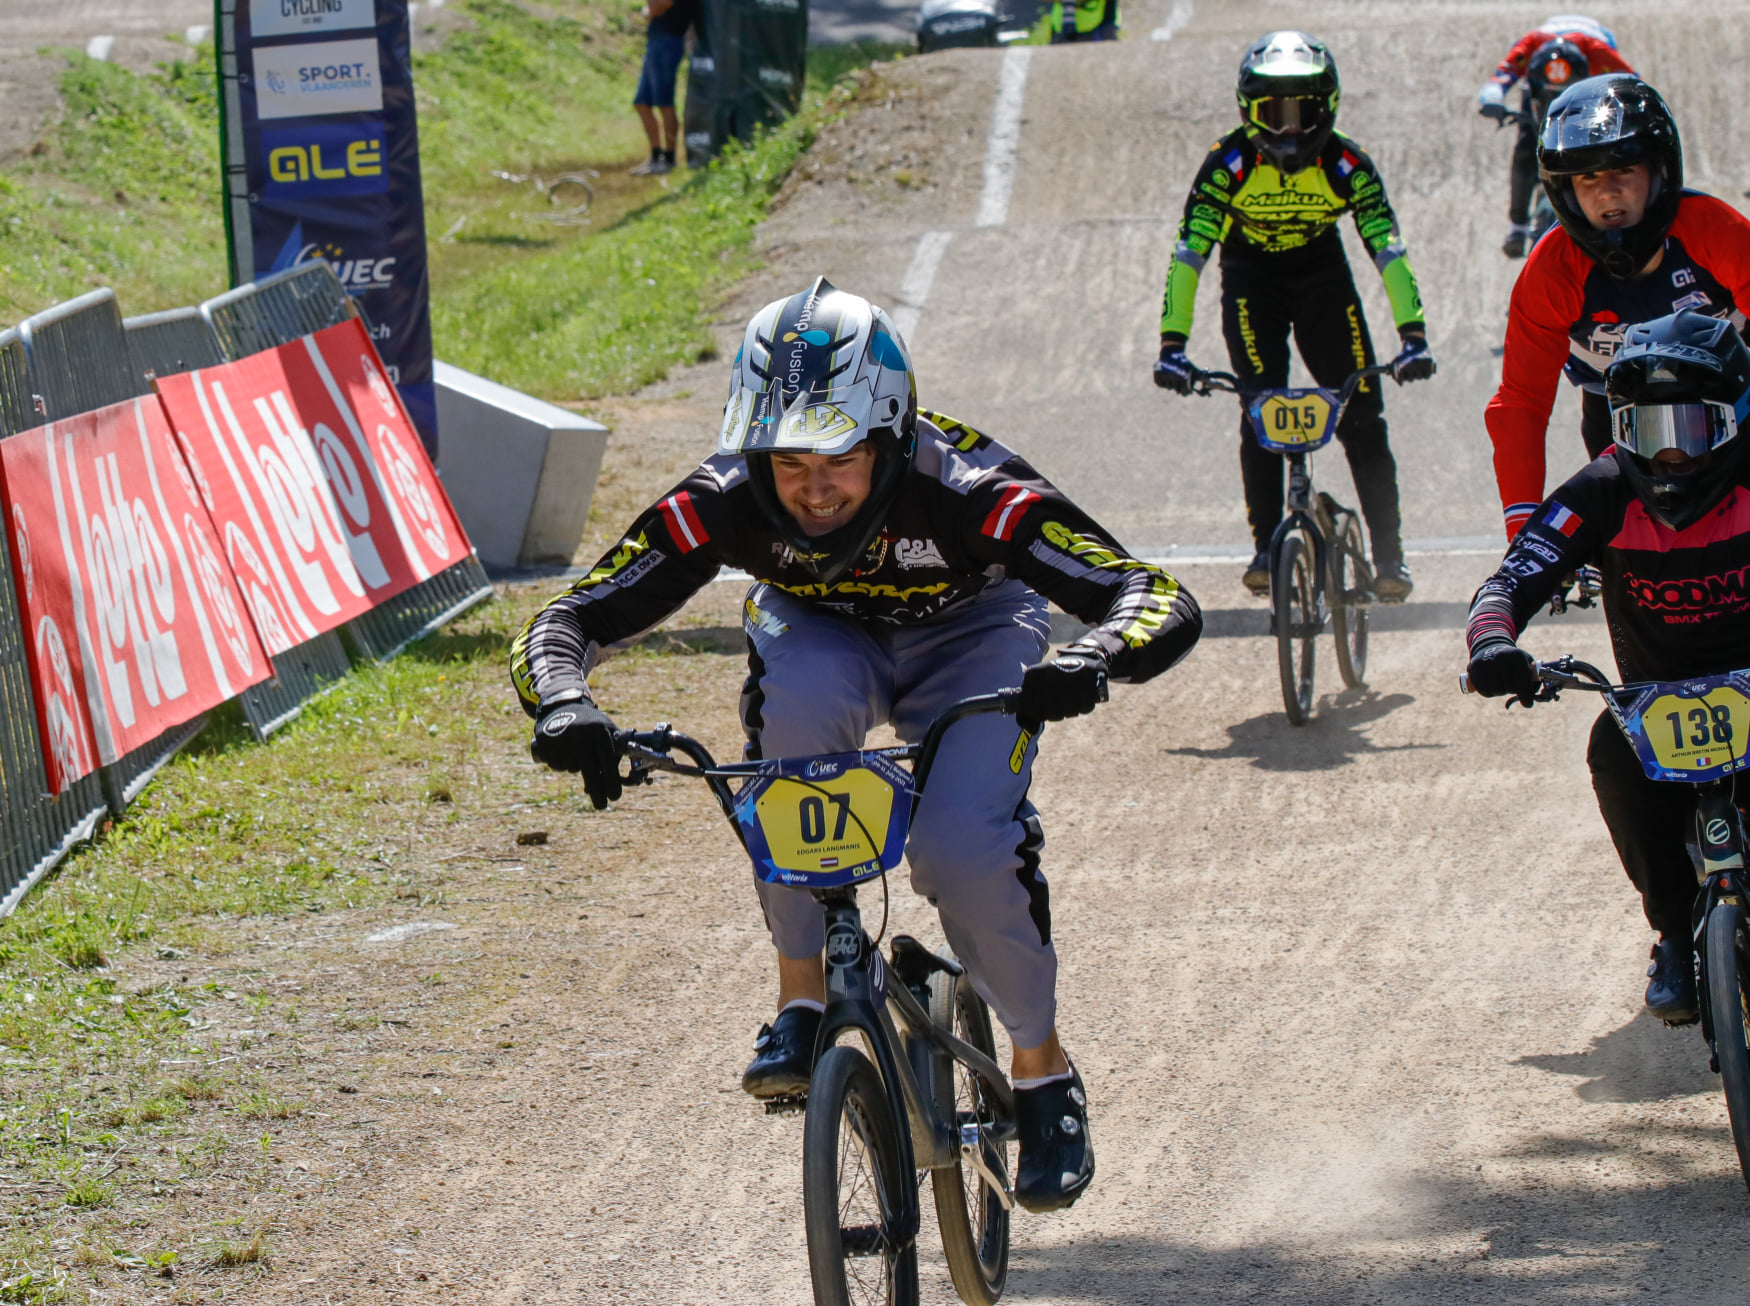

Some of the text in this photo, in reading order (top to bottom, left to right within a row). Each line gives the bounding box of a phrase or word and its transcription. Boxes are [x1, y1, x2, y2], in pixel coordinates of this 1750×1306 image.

[298, 63, 371, 82] SPORT.
[332, 257, 396, 283] UEC
[788, 341, 808, 393] Fusion
[1275, 406, 1316, 430] 015
[1664, 614, 1701, 624] BMX
[1666, 705, 1733, 749] 138
[799, 793, 850, 844] 07
[797, 843, 860, 856] EDGARS LANGMANIS
